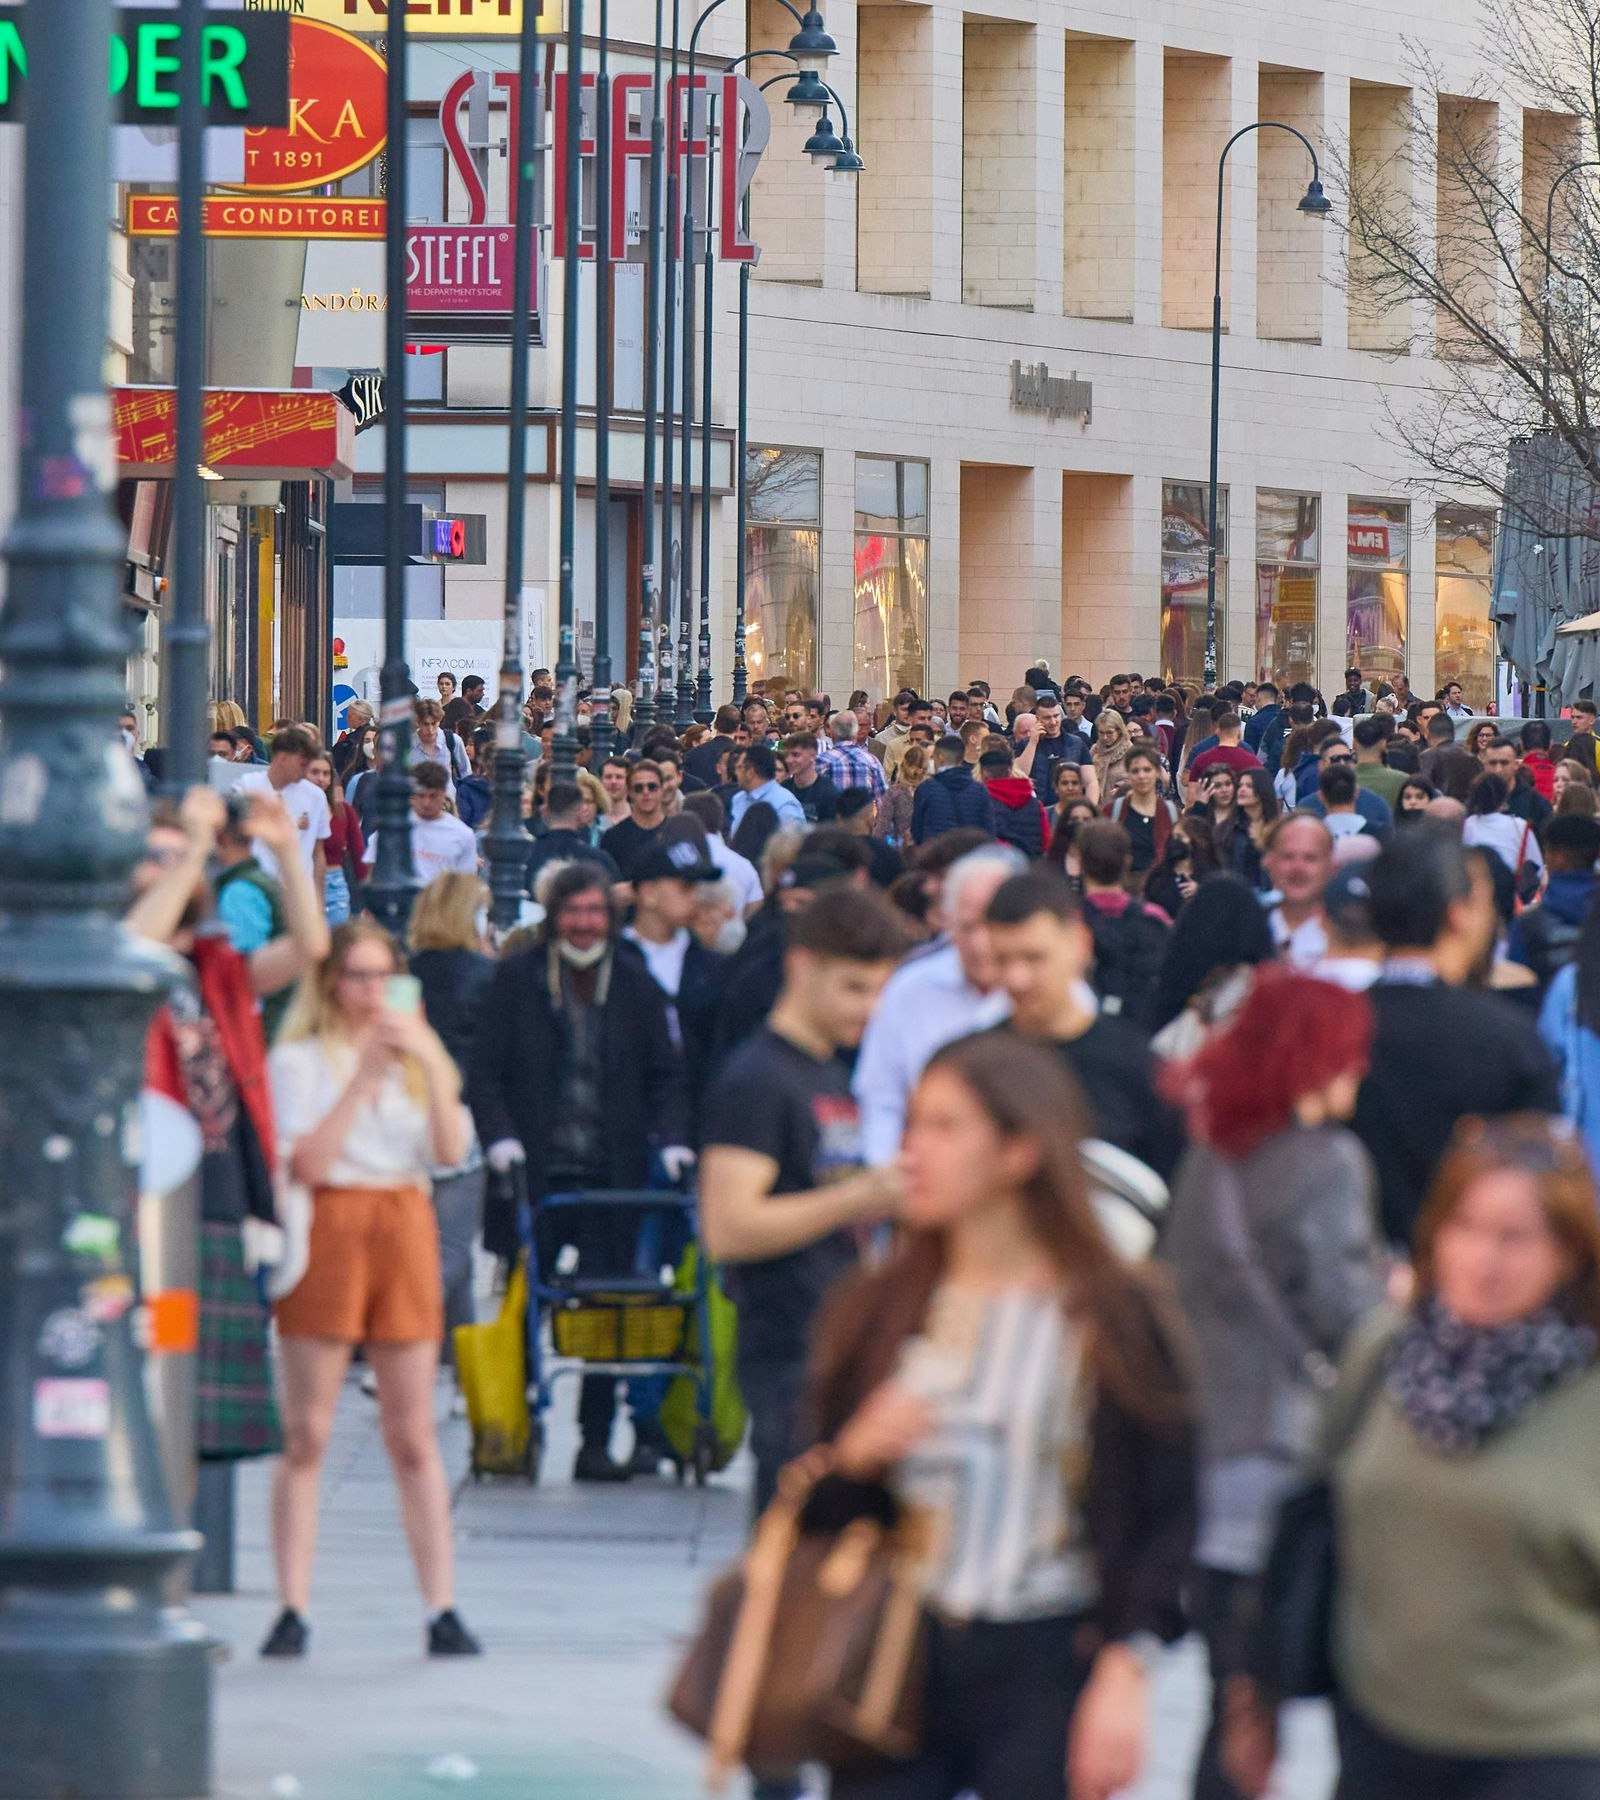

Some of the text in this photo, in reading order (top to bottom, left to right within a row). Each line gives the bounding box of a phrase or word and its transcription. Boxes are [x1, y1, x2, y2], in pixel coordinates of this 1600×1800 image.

[245, 98, 366, 144] KA
[273, 152, 323, 168] 1891
[222, 207, 379, 227] CONDITOREI
[424, 288, 475, 297] DEPARTMENT
[477, 288, 503, 297] STORE
[352, 376, 388, 426] SIK
